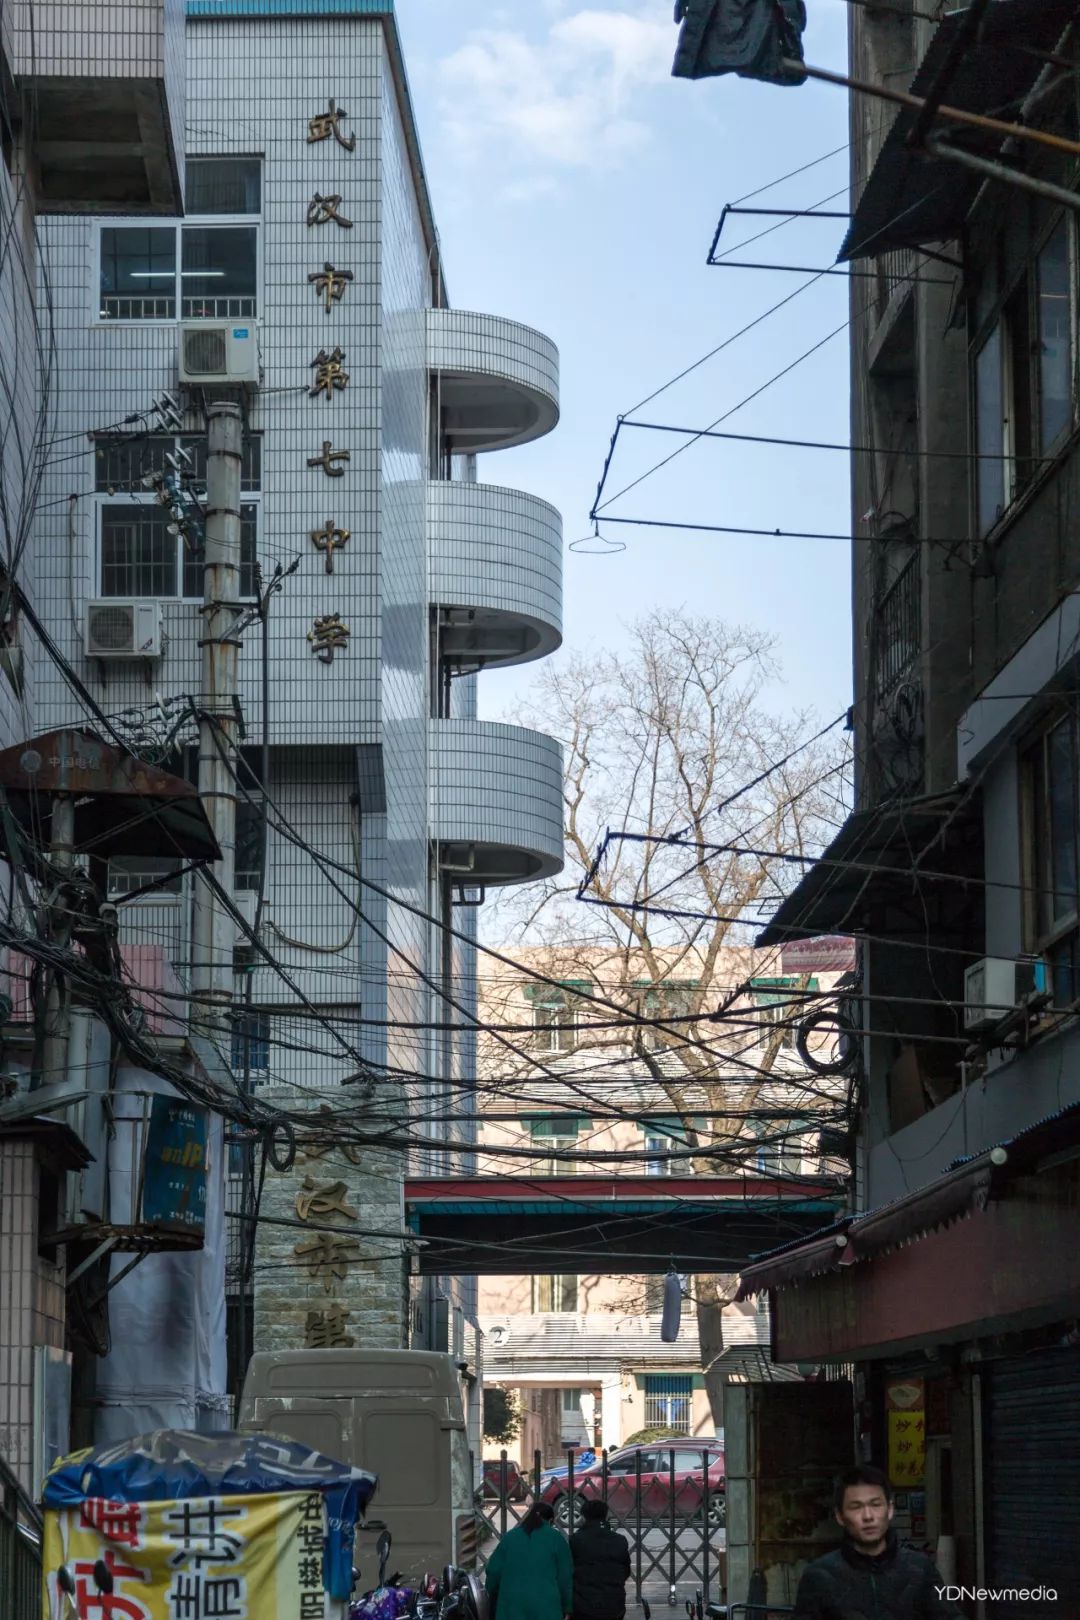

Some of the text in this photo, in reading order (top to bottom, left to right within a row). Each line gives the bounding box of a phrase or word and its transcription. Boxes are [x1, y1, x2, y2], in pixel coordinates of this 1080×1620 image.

[307, 98, 356, 664] 武汉市第七中学
[494, 1329, 503, 1343] 2
